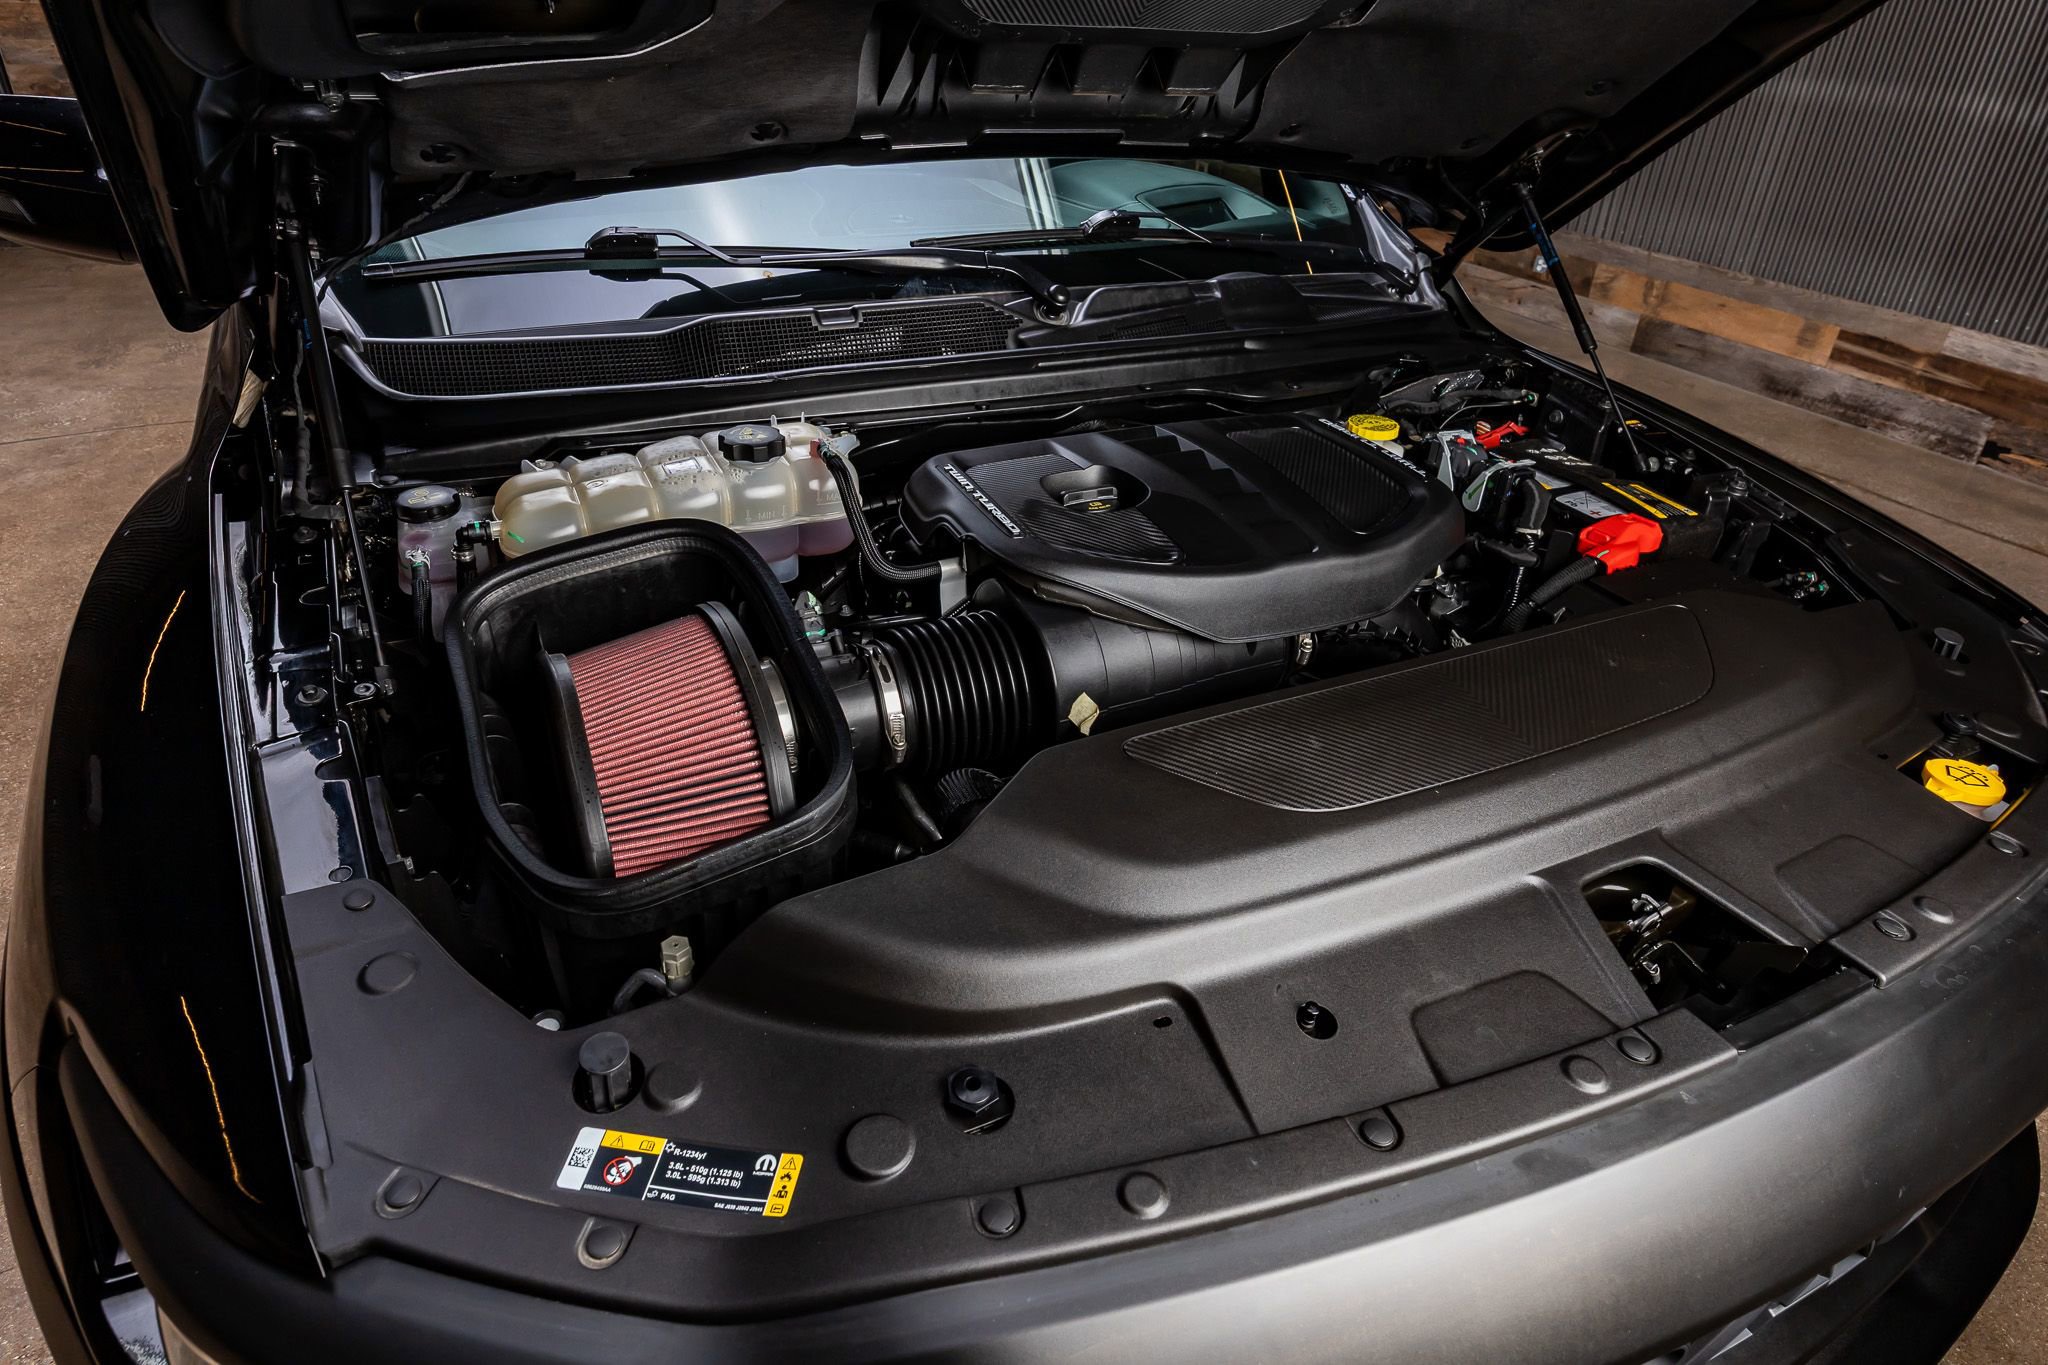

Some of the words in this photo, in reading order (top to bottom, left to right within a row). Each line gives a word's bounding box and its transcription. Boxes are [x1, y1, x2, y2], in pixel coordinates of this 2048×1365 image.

[943, 463, 975, 492] TWIN
[973, 489, 1021, 535] TURBO
[758, 511, 776, 520] MIN
[674, 1148, 707, 1160] R-1234yf
[668, 1162, 684, 1170] 3.6L
[690, 1165, 708, 1174] 510g
[709, 1168, 730, 1177] (1.125
[733, 1170, 744, 1180] lb)
[666, 1170, 682, 1180] 3.0L
[688, 1174, 706, 1184] 595g
[706, 1177, 729, 1186] (1.313
[730, 1180, 742, 1188] lb)
[660, 1192, 676, 1200] PAG
